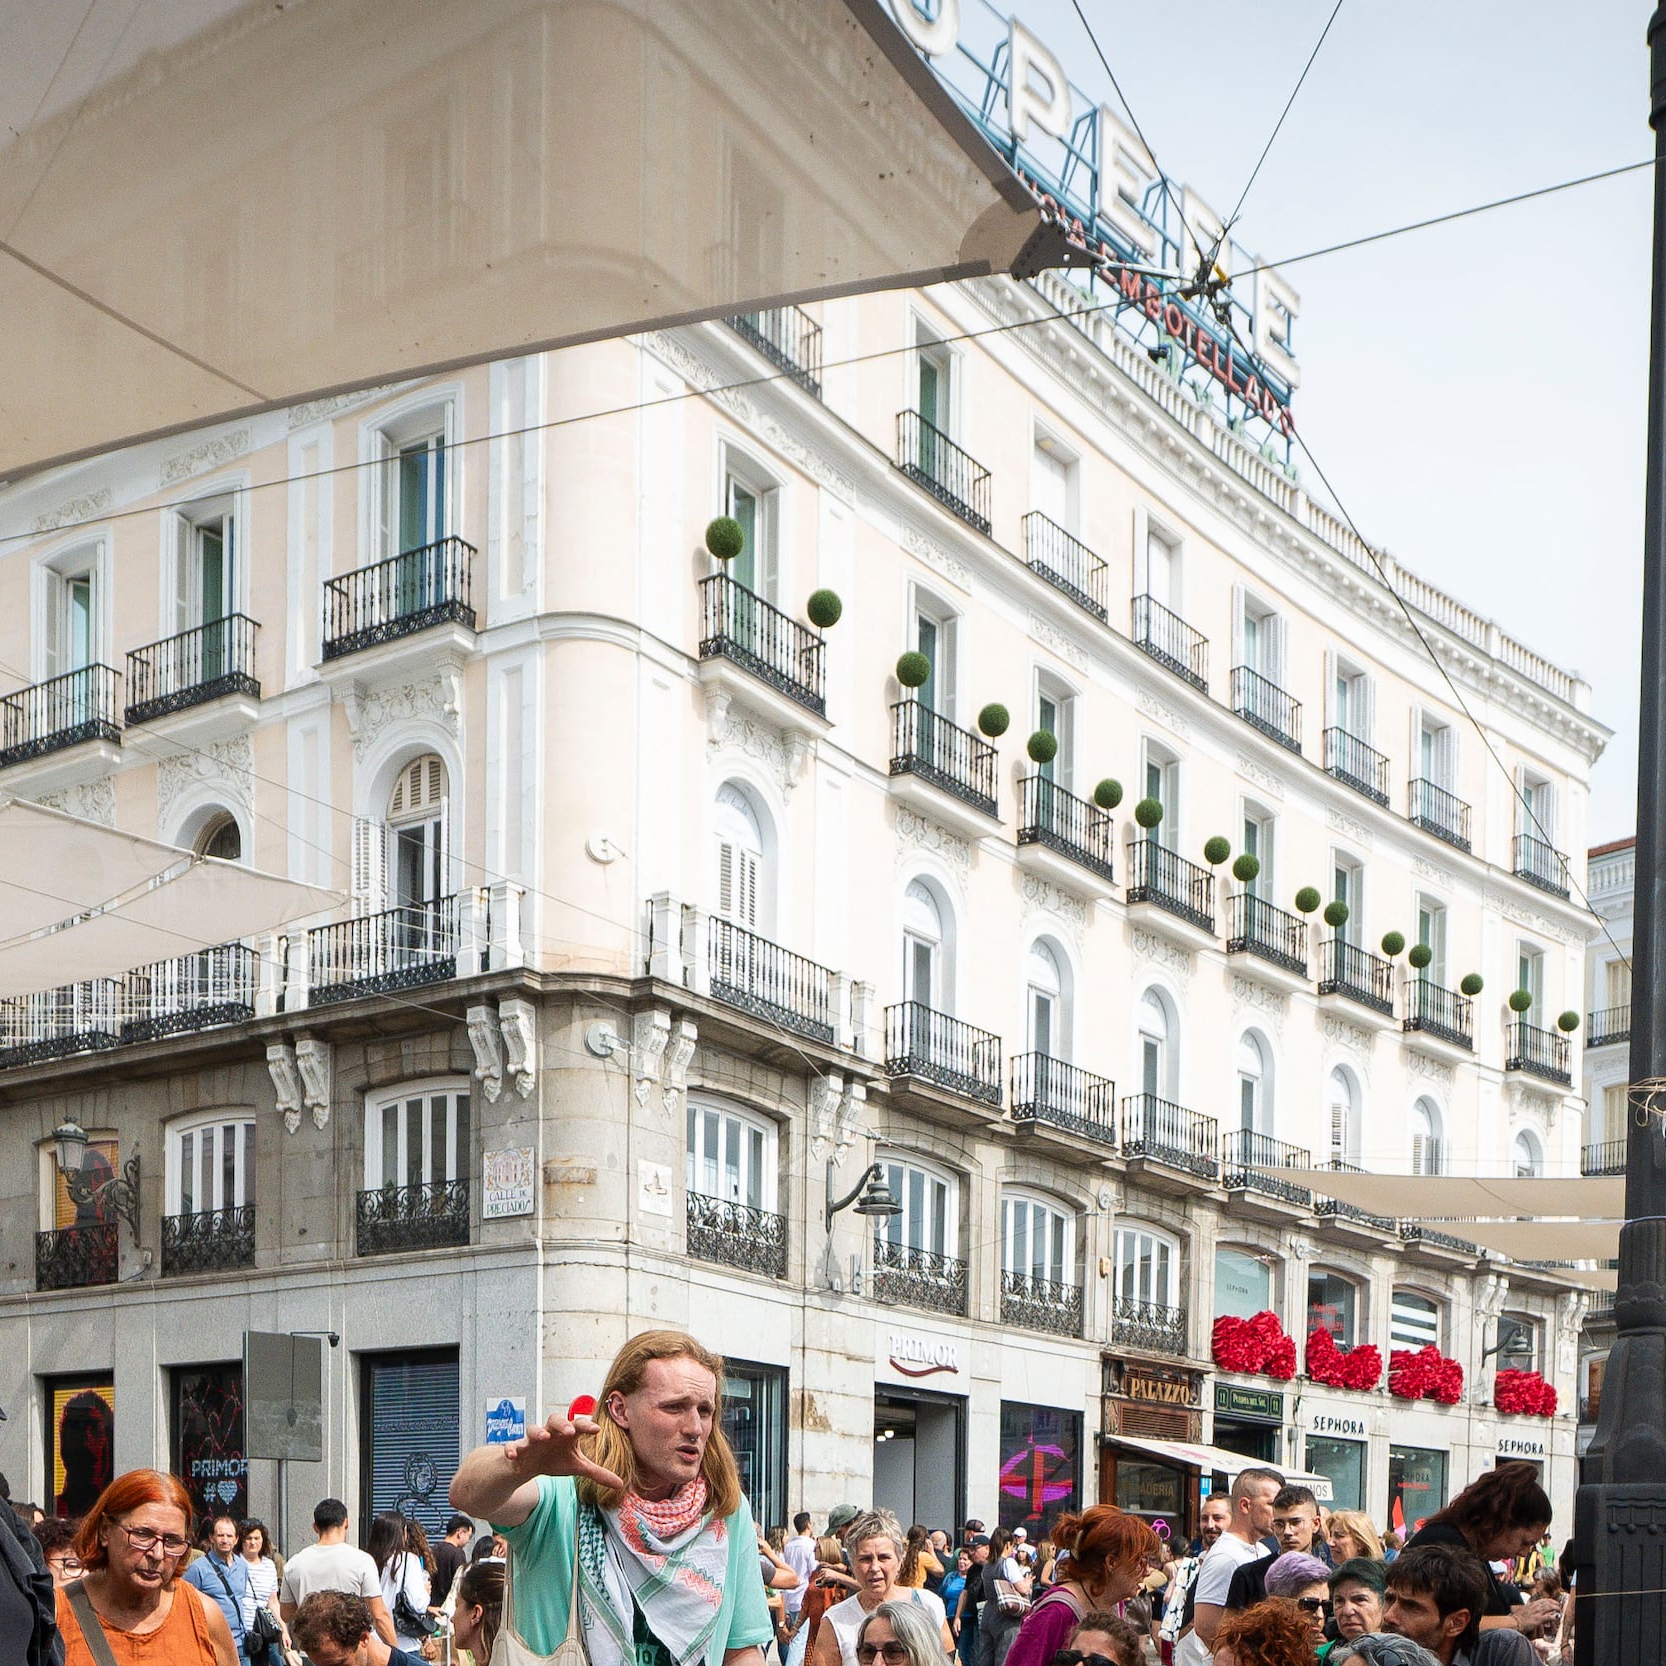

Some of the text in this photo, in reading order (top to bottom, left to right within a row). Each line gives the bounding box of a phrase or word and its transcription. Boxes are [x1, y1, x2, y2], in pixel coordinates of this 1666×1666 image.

[1099, 242, 1295, 440] EMBOTELLADO
[489, 1189, 516, 1202] CALLE
[486, 1199, 531, 1216] PRECIADOS
[889, 1334, 959, 1369] PRIMOR
[1130, 1376, 1190, 1405] PALAZZO
[1313, 1415, 1365, 1435] SEPHORA
[1498, 1438, 1545, 1455] SEPHORA
